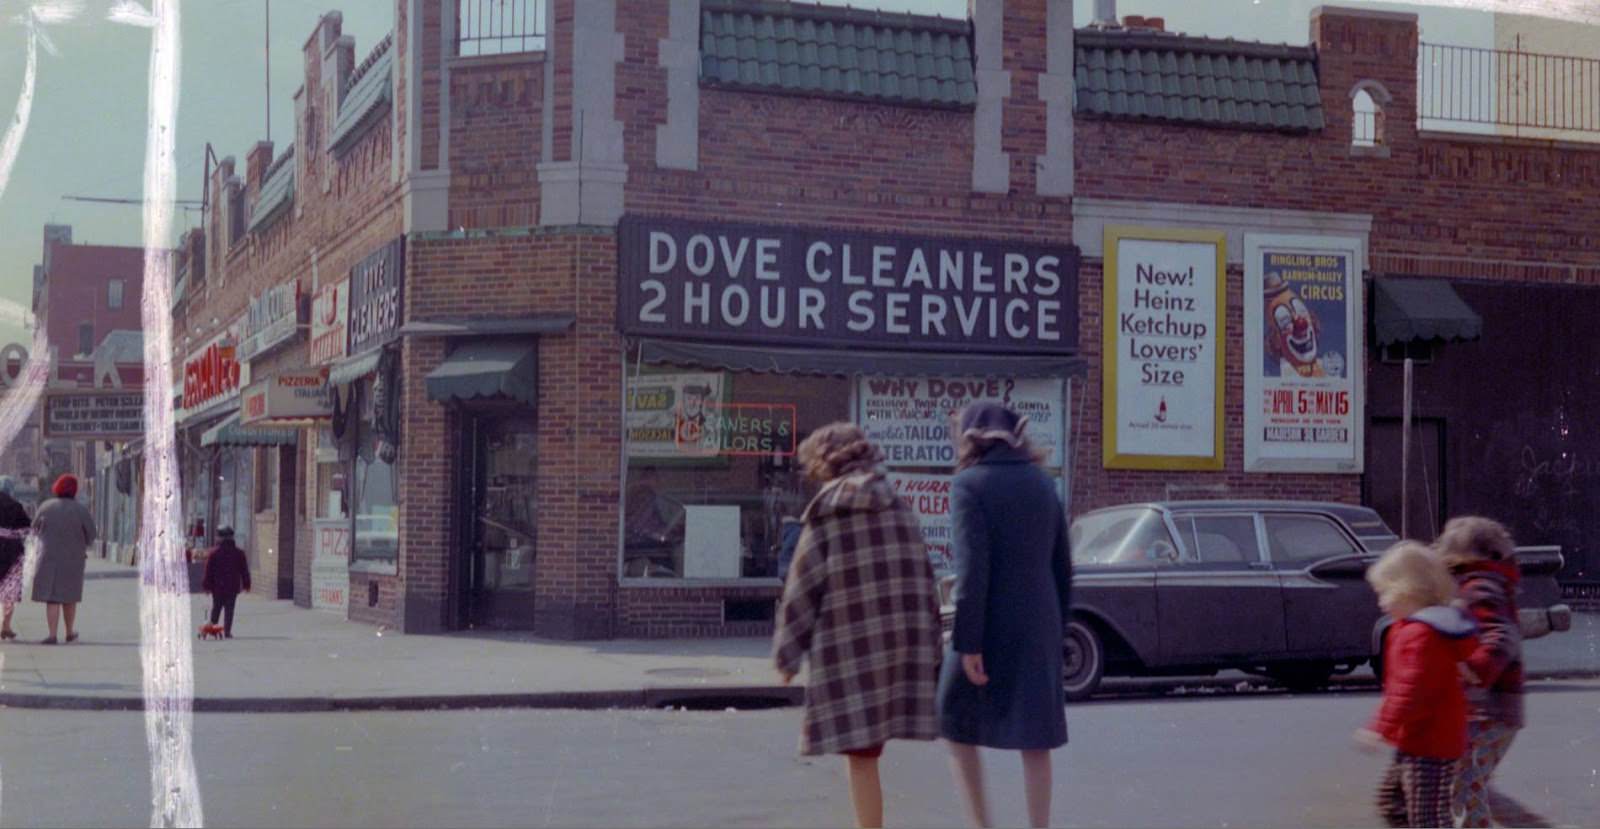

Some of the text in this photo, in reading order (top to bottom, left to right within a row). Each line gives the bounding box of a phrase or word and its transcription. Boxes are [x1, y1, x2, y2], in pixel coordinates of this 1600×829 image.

[649, 231, 1060, 297] DOVE CLEANERS
[1271, 254, 1312, 266] RINGLING
[1136, 263, 1194, 286] New!
[1134, 288, 1195, 311] Heinz
[1301, 284, 1344, 300] CIRCUS
[351, 287, 398, 347] CLEANERS
[639, 279, 1061, 340] 2 HOUR SERVICE
[1120, 313, 1207, 339] Ketchup
[1130, 339, 1203, 361] Lovers'
[278, 375, 321, 387] PIZZERIA
[1141, 363, 1185, 385] Size
[868, 378, 919, 398] WHY
[1272, 390, 1295, 414] APRIL
[1298, 390, 1308, 414] 5
[1315, 391, 1335, 414] MAY
[1335, 391, 1349, 415] 15
[866, 409, 892, 419] WITH
[777, 420, 791, 438] &
[700, 434, 773, 453] AILORS
